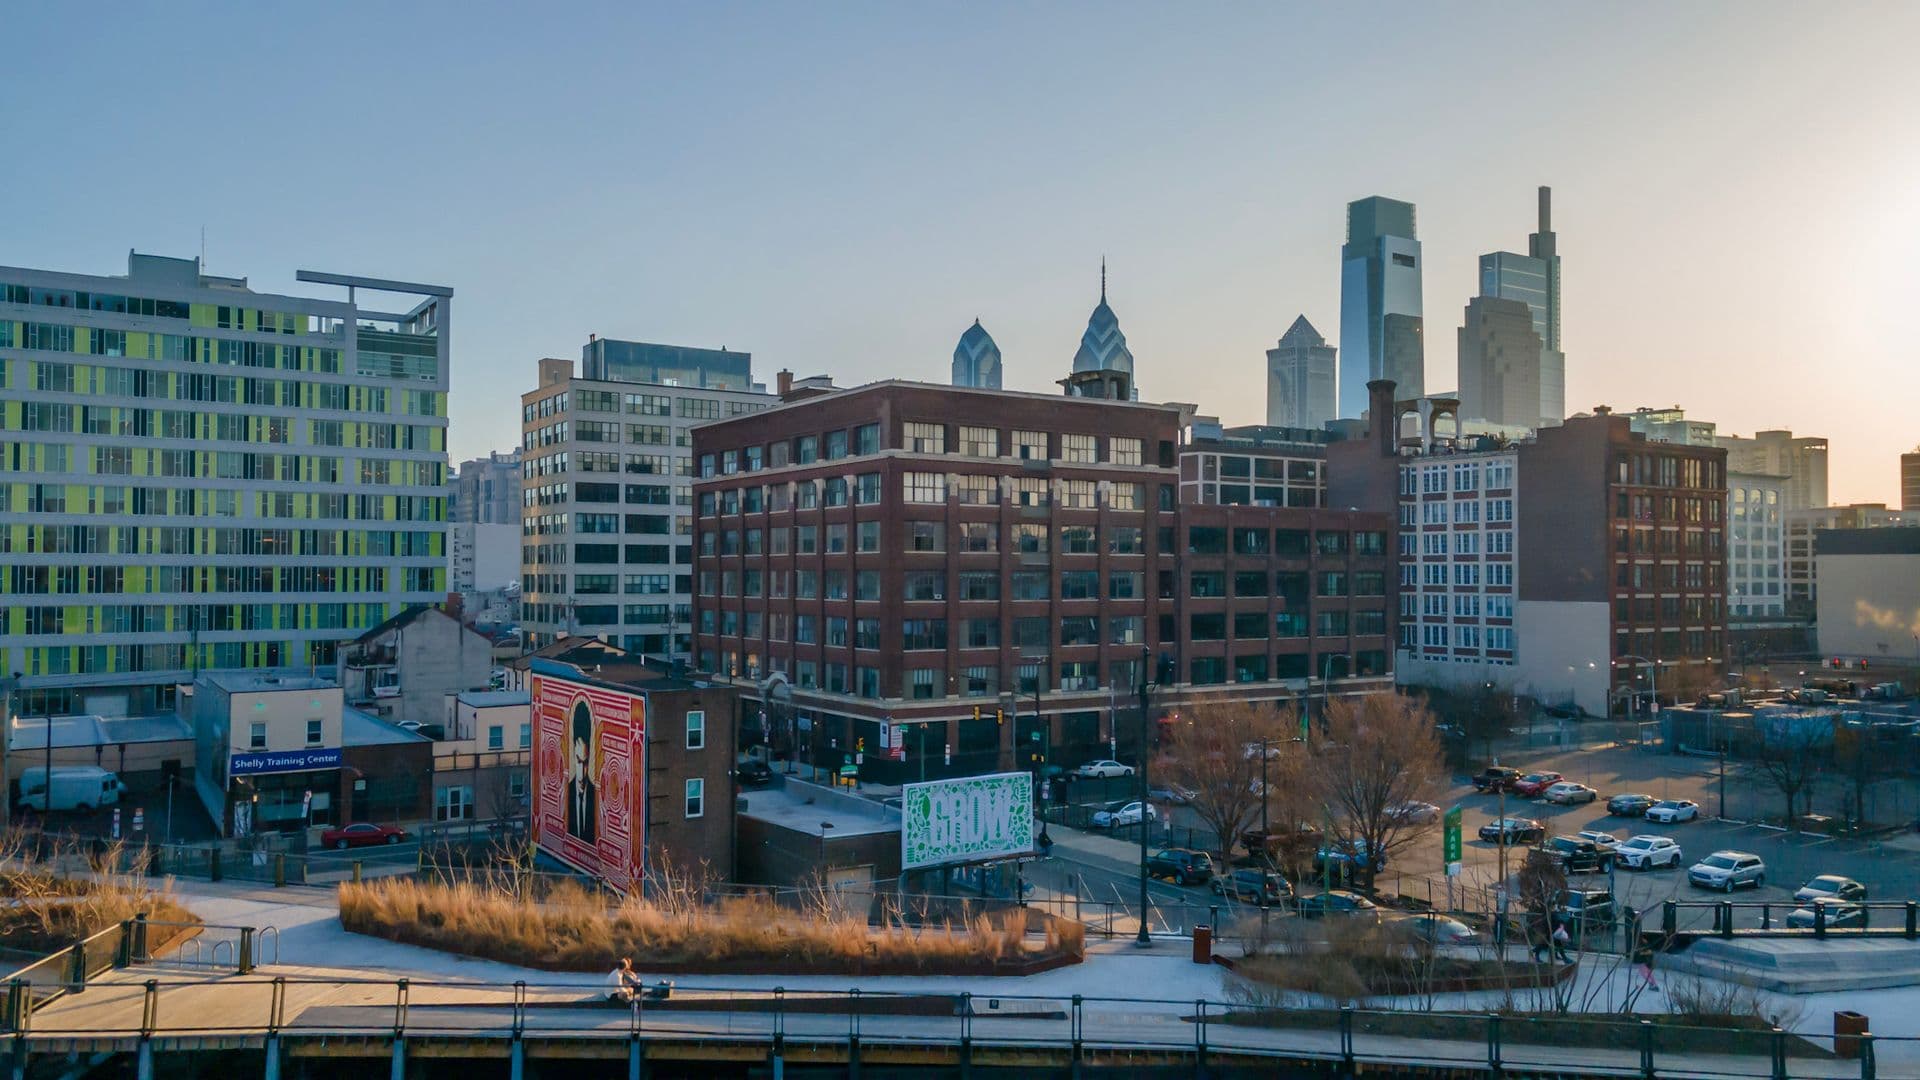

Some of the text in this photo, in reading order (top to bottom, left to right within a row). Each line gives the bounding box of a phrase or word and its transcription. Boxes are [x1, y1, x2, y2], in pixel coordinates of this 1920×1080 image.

[235, 755, 338, 769] Shelly Training Center
